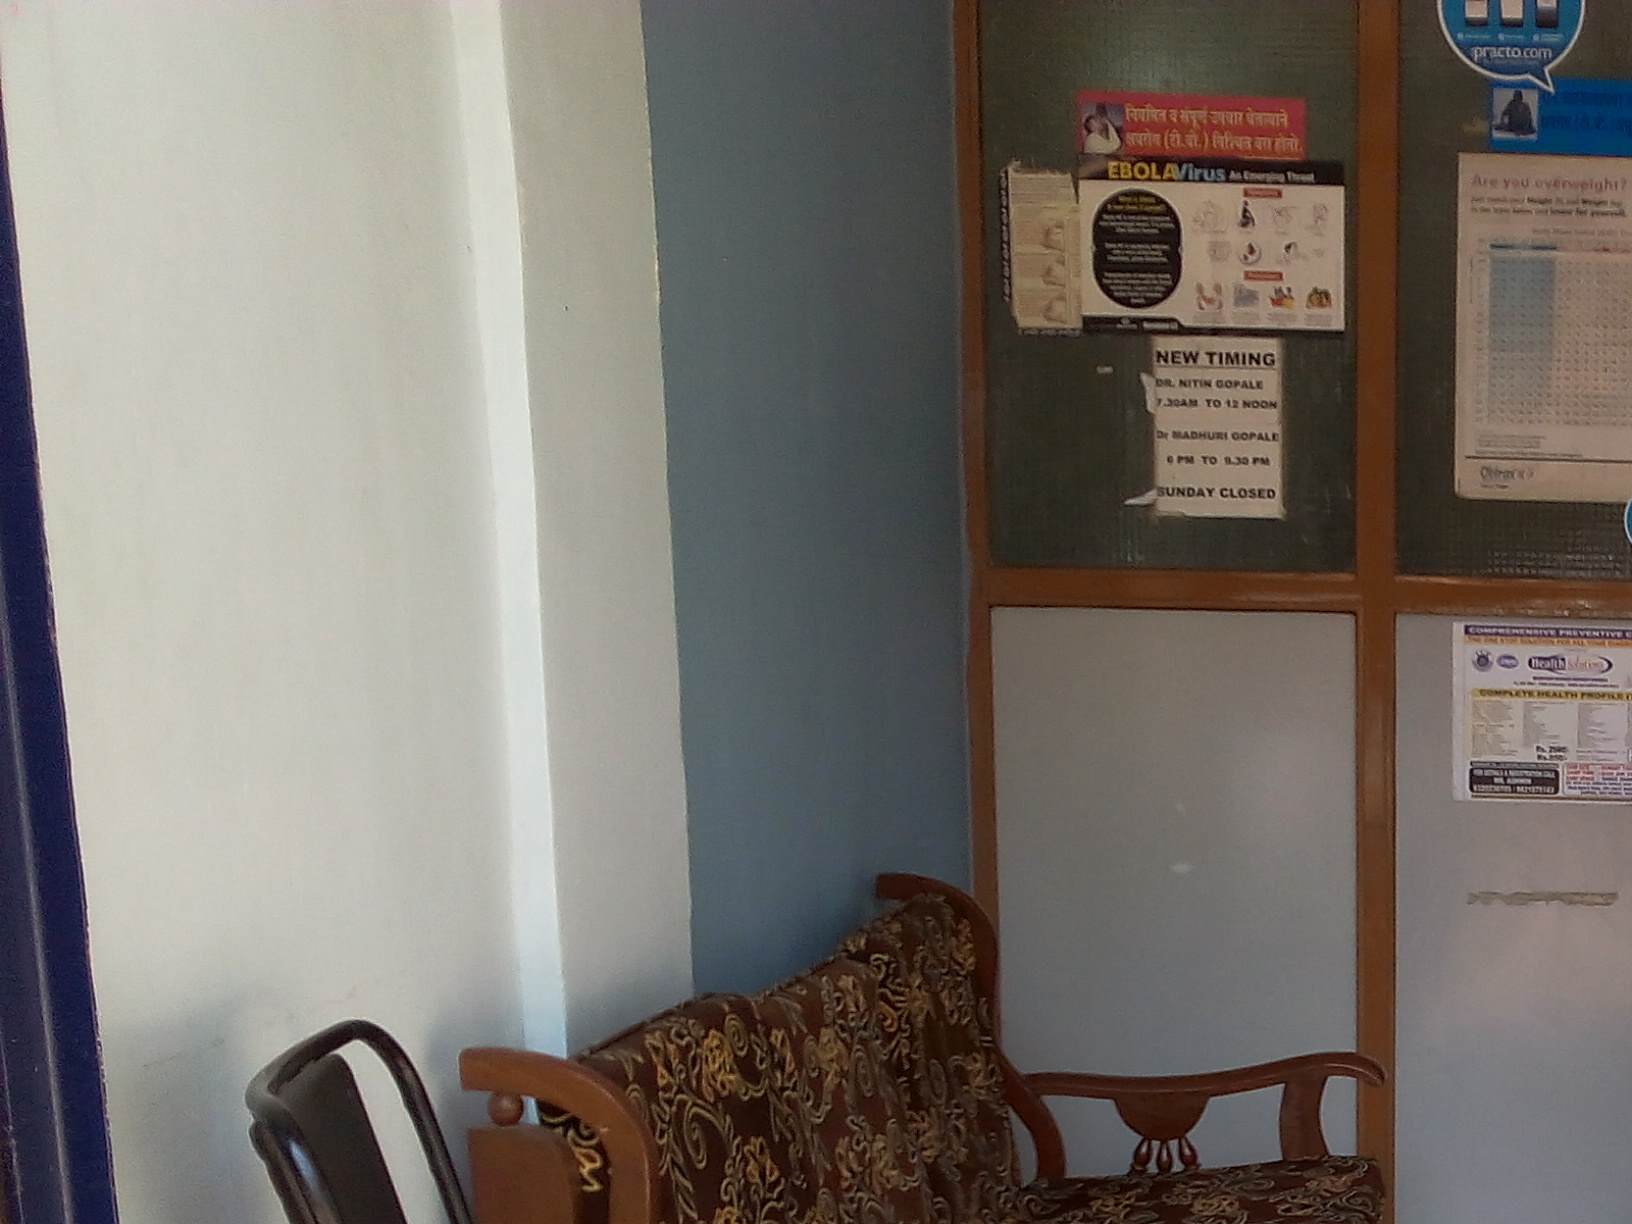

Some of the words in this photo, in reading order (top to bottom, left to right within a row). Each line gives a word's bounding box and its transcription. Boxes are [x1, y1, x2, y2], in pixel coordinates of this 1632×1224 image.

[1471, 174, 1499, 188] Are
[1503, 178, 1529, 191] you
[1535, 178, 1627, 192] overweight?
[1156, 350, 1200, 365] NEW
[1205, 352, 1276, 366] TIMING
[1179, 379, 1212, 388] NITIN
[1216, 379, 1263, 390] GOPALE
[1205, 399, 1222, 409] TO
[1227, 400, 1239, 409] 12
[1242, 400, 1278, 410] NOON
[1172, 431, 1228, 441] MADHURI
[1232, 431, 1279, 442] GOPALE
[1177, 456, 1195, 465] PM
[1202, 456, 1217, 465] TO
[1252, 457, 1271, 466] PM
[1156, 486, 1215, 498] SUNDAY
[1219, 487, 1276, 499] CLOSED
[1468, 627, 1557, 636] COMPREHENSIVE
[1559, 628, 1622, 638] PREVENTIVE
[1531, 657, 1566, 670] Health
[1480, 689, 1533, 698] COMPLETE
[1536, 690, 1578, 699] HEALTH
[1581, 691, 1621, 700] PROFILE
